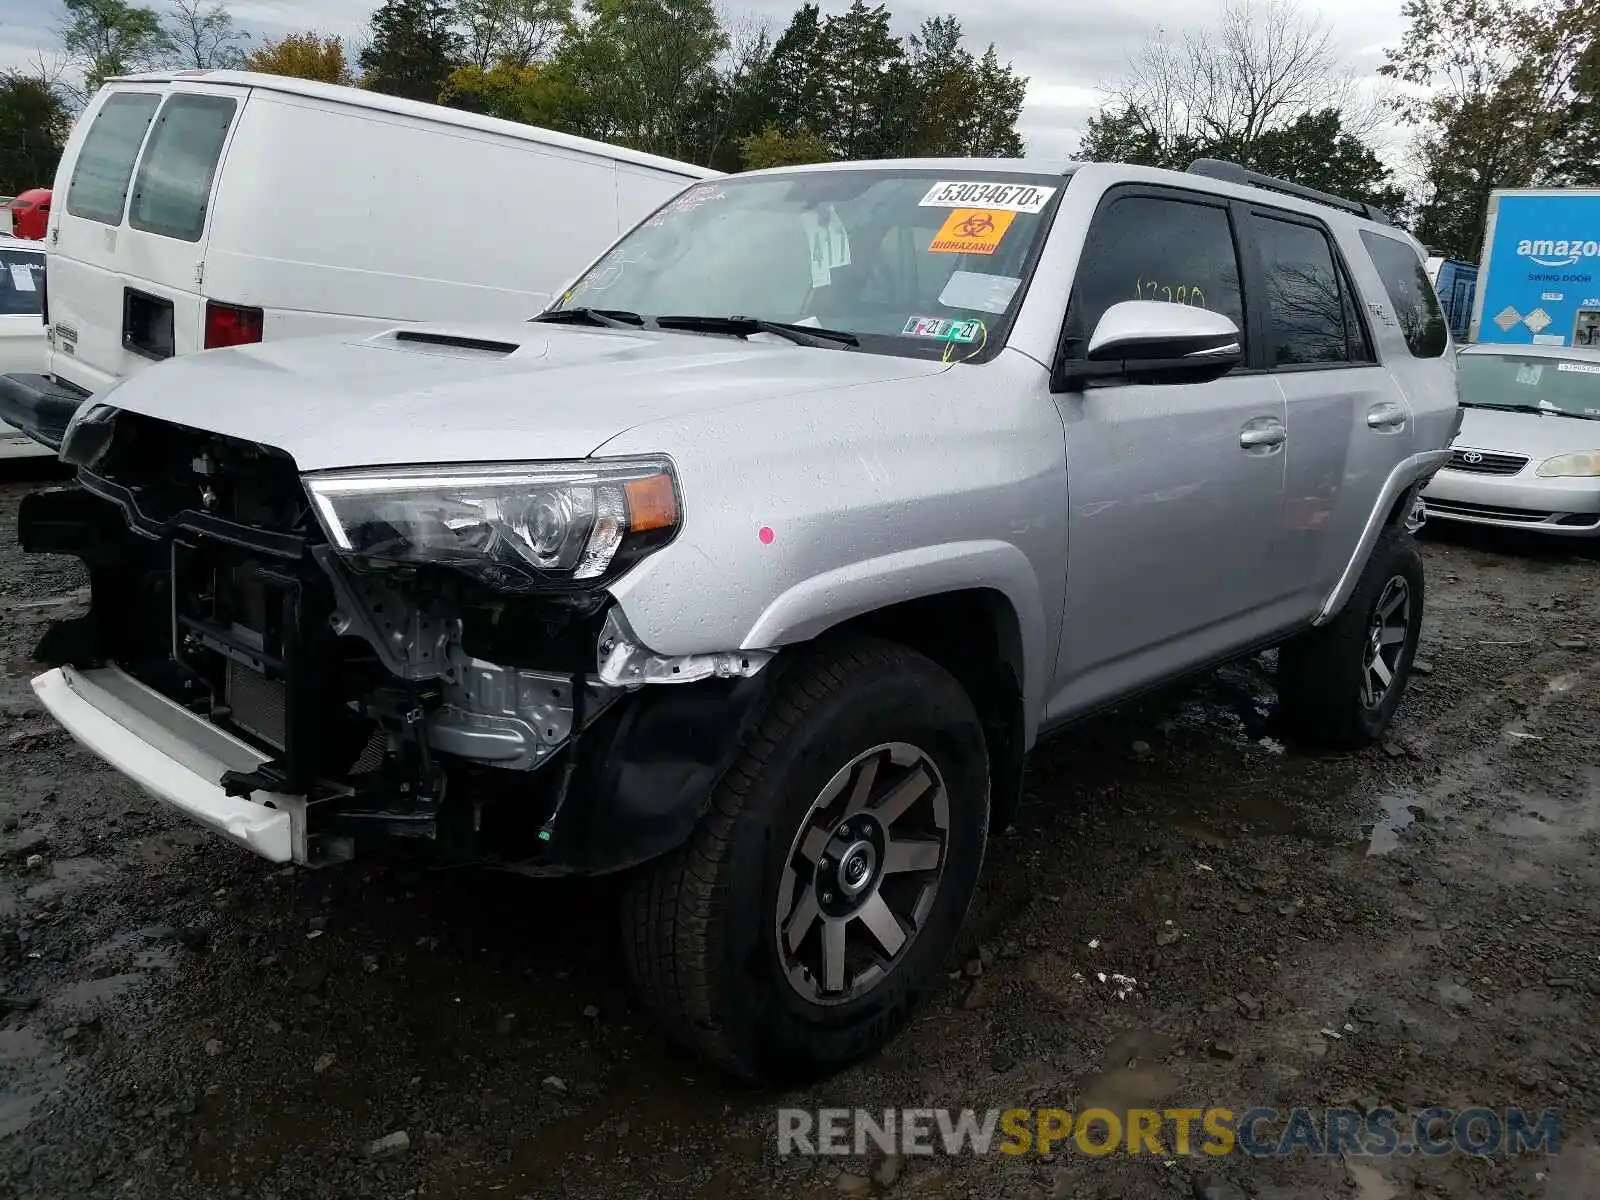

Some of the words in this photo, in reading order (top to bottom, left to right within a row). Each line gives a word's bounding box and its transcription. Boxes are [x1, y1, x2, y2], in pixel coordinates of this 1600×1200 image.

[931, 240, 996, 251] BIOHAZARD
[1528, 273, 1560, 282] SWING
[1562, 274, 1592, 283] DOOR
[927, 319, 940, 334] 21
[961, 323, 975, 338] 21
